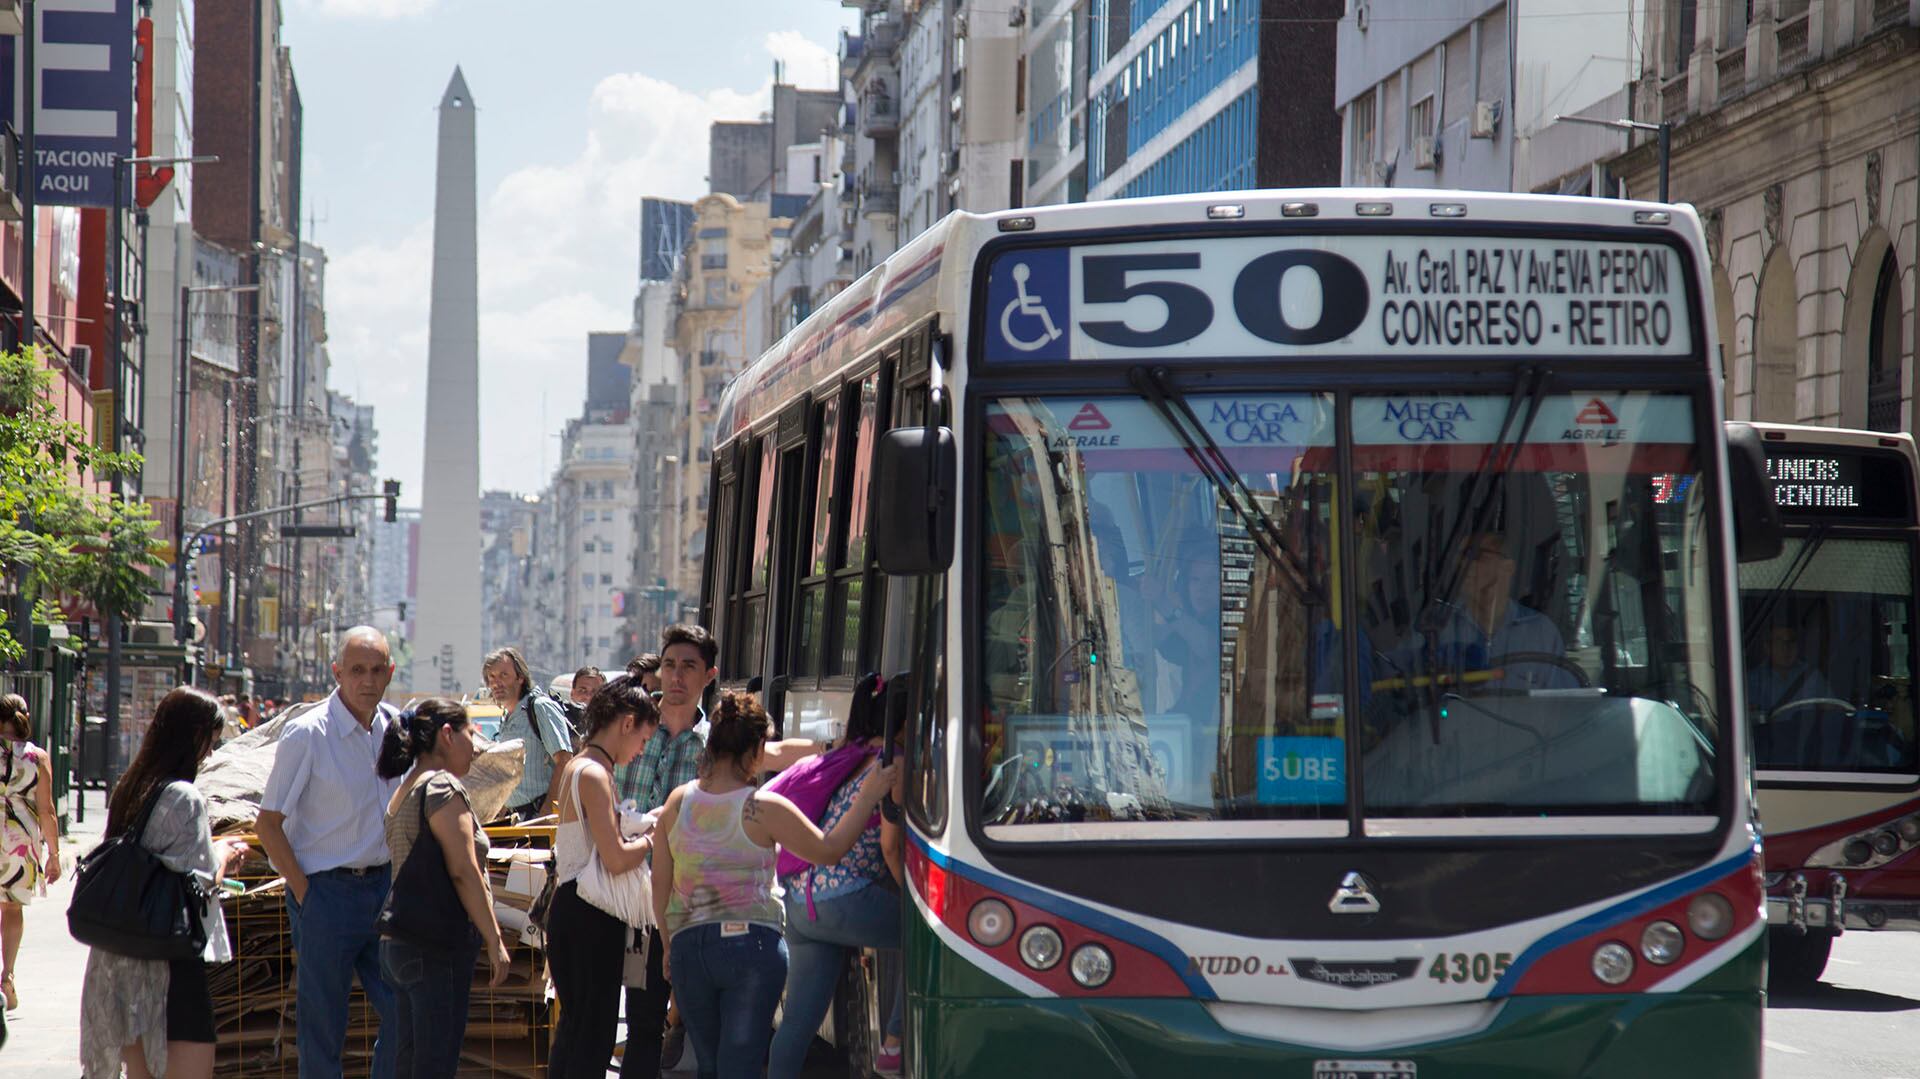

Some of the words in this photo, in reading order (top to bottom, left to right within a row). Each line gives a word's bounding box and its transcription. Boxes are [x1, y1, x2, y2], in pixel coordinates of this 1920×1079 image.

[40, 174, 90, 192] AQUI
[1383, 249, 1411, 294] Av.
[1417, 249, 1460, 294] Gral.
[1466, 249, 1505, 294] PAZ
[1510, 249, 1524, 294] Y
[1599, 250, 1669, 294] PERON
[1079, 248, 1370, 347] 50
[1382, 300, 1542, 345] CONGRESO
[1569, 300, 1671, 345] RETIRO
[1210, 400, 1302, 422] MEGA
[1383, 400, 1474, 421] MEGA
[1225, 420, 1286, 443] CAR
[1399, 420, 1461, 441] CAR
[1561, 428, 1628, 440] AGRALE
[1766, 458, 1839, 480] LINIERS
[1775, 485, 1859, 507] CENTRAL
[1264, 756, 1337, 782] SUBE
[1186, 956, 1261, 975] NUDO
[1428, 952, 1513, 983] 4305
